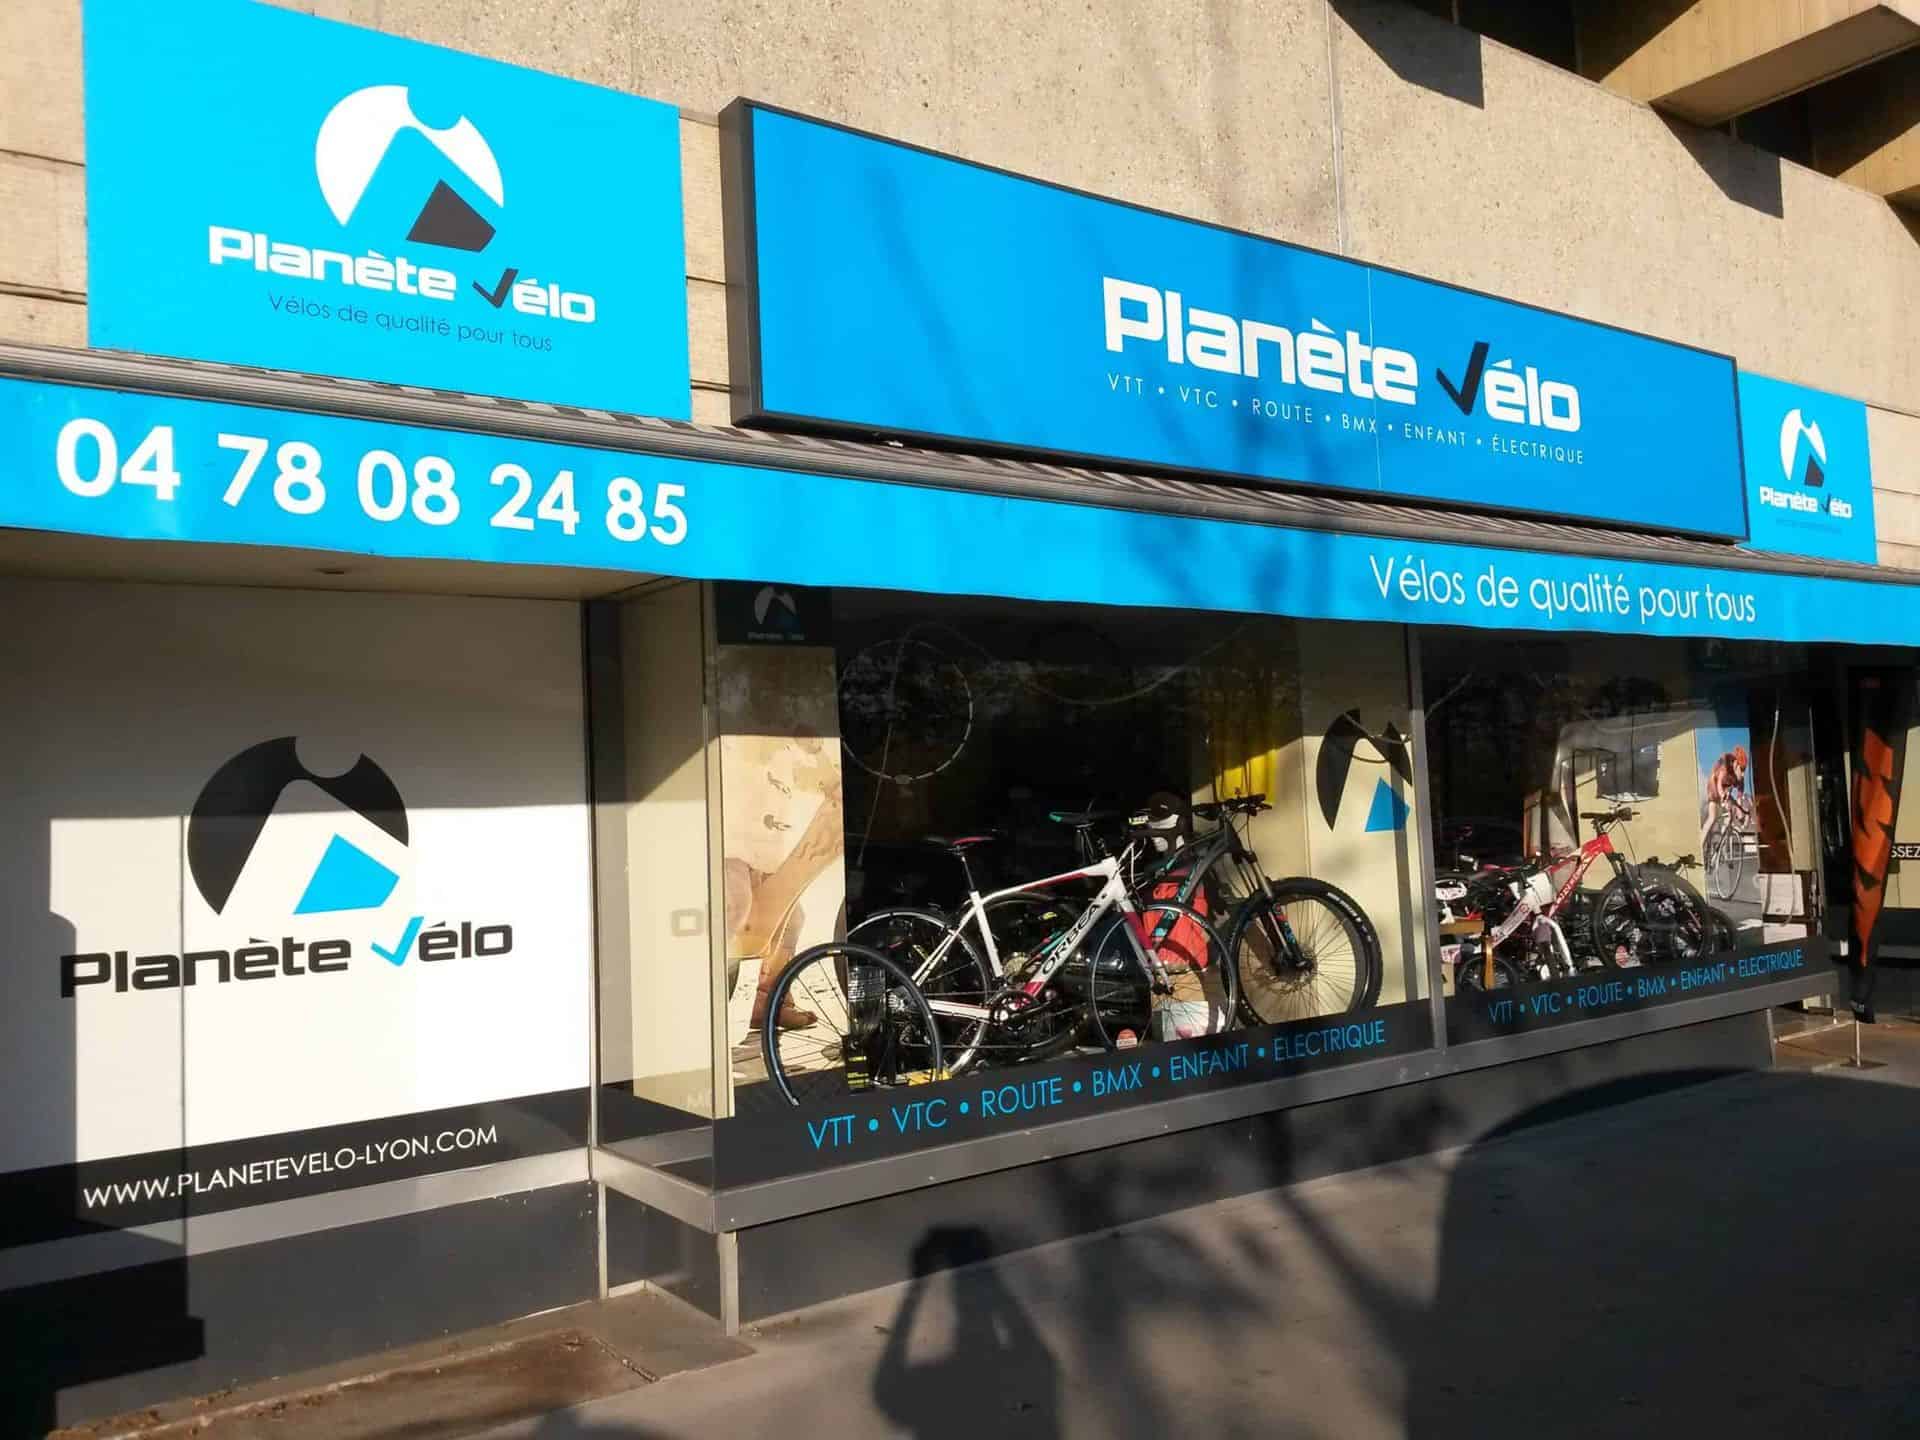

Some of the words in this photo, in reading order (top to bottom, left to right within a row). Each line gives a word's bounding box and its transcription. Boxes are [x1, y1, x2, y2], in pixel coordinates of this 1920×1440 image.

[208, 224, 457, 301] Planète
[268, 291, 331, 320] Vélos
[337, 304, 368, 324] de
[375, 311, 451, 337] qualité
[457, 323, 505, 343] pour
[512, 331, 552, 352] tous
[1103, 276, 1419, 406] Planète
[1107, 372, 1144, 396] VTT
[1179, 385, 1219, 409] VTC
[1252, 398, 1313, 424] ROUTE
[1342, 413, 1377, 434] BMX
[1404, 423, 1466, 447] ENFANT
[1492, 435, 1583, 465] ÉLECTRIQUE
[56, 417, 181, 501] 04
[216, 433, 326, 516] 78
[357, 449, 460, 527] 08
[489, 464, 580, 536] 24
[605, 477, 688, 546] 85
[1369, 554, 1466, 605] Vélos
[1476, 565, 1519, 609] de
[1529, 573, 1630, 620] qualité
[1640, 585, 1699, 624] pour
[1705, 583, 1756, 622] tous
[60, 937, 352, 998] Planète
[1042, 903, 1100, 975] ORBEA
[1489, 999, 1513, 1025] VTT
[1531, 992, 1561, 1016] VTC
[1577, 982, 1622, 1008] ROUTE
[1637, 976, 1667, 998] BMX
[1680, 962, 1727, 990] ENFANT
[807, 1114, 856, 1149] VTT
[892, 1099, 947, 1133] VTC
[982, 1077, 1063, 1117] ROUTE
[1092, 1063, 1143, 1097] BMX
[1170, 1043, 1249, 1081] ENFANT
[83, 1125, 498, 1209] WWW.PLANETEVELO-LYON.COM
